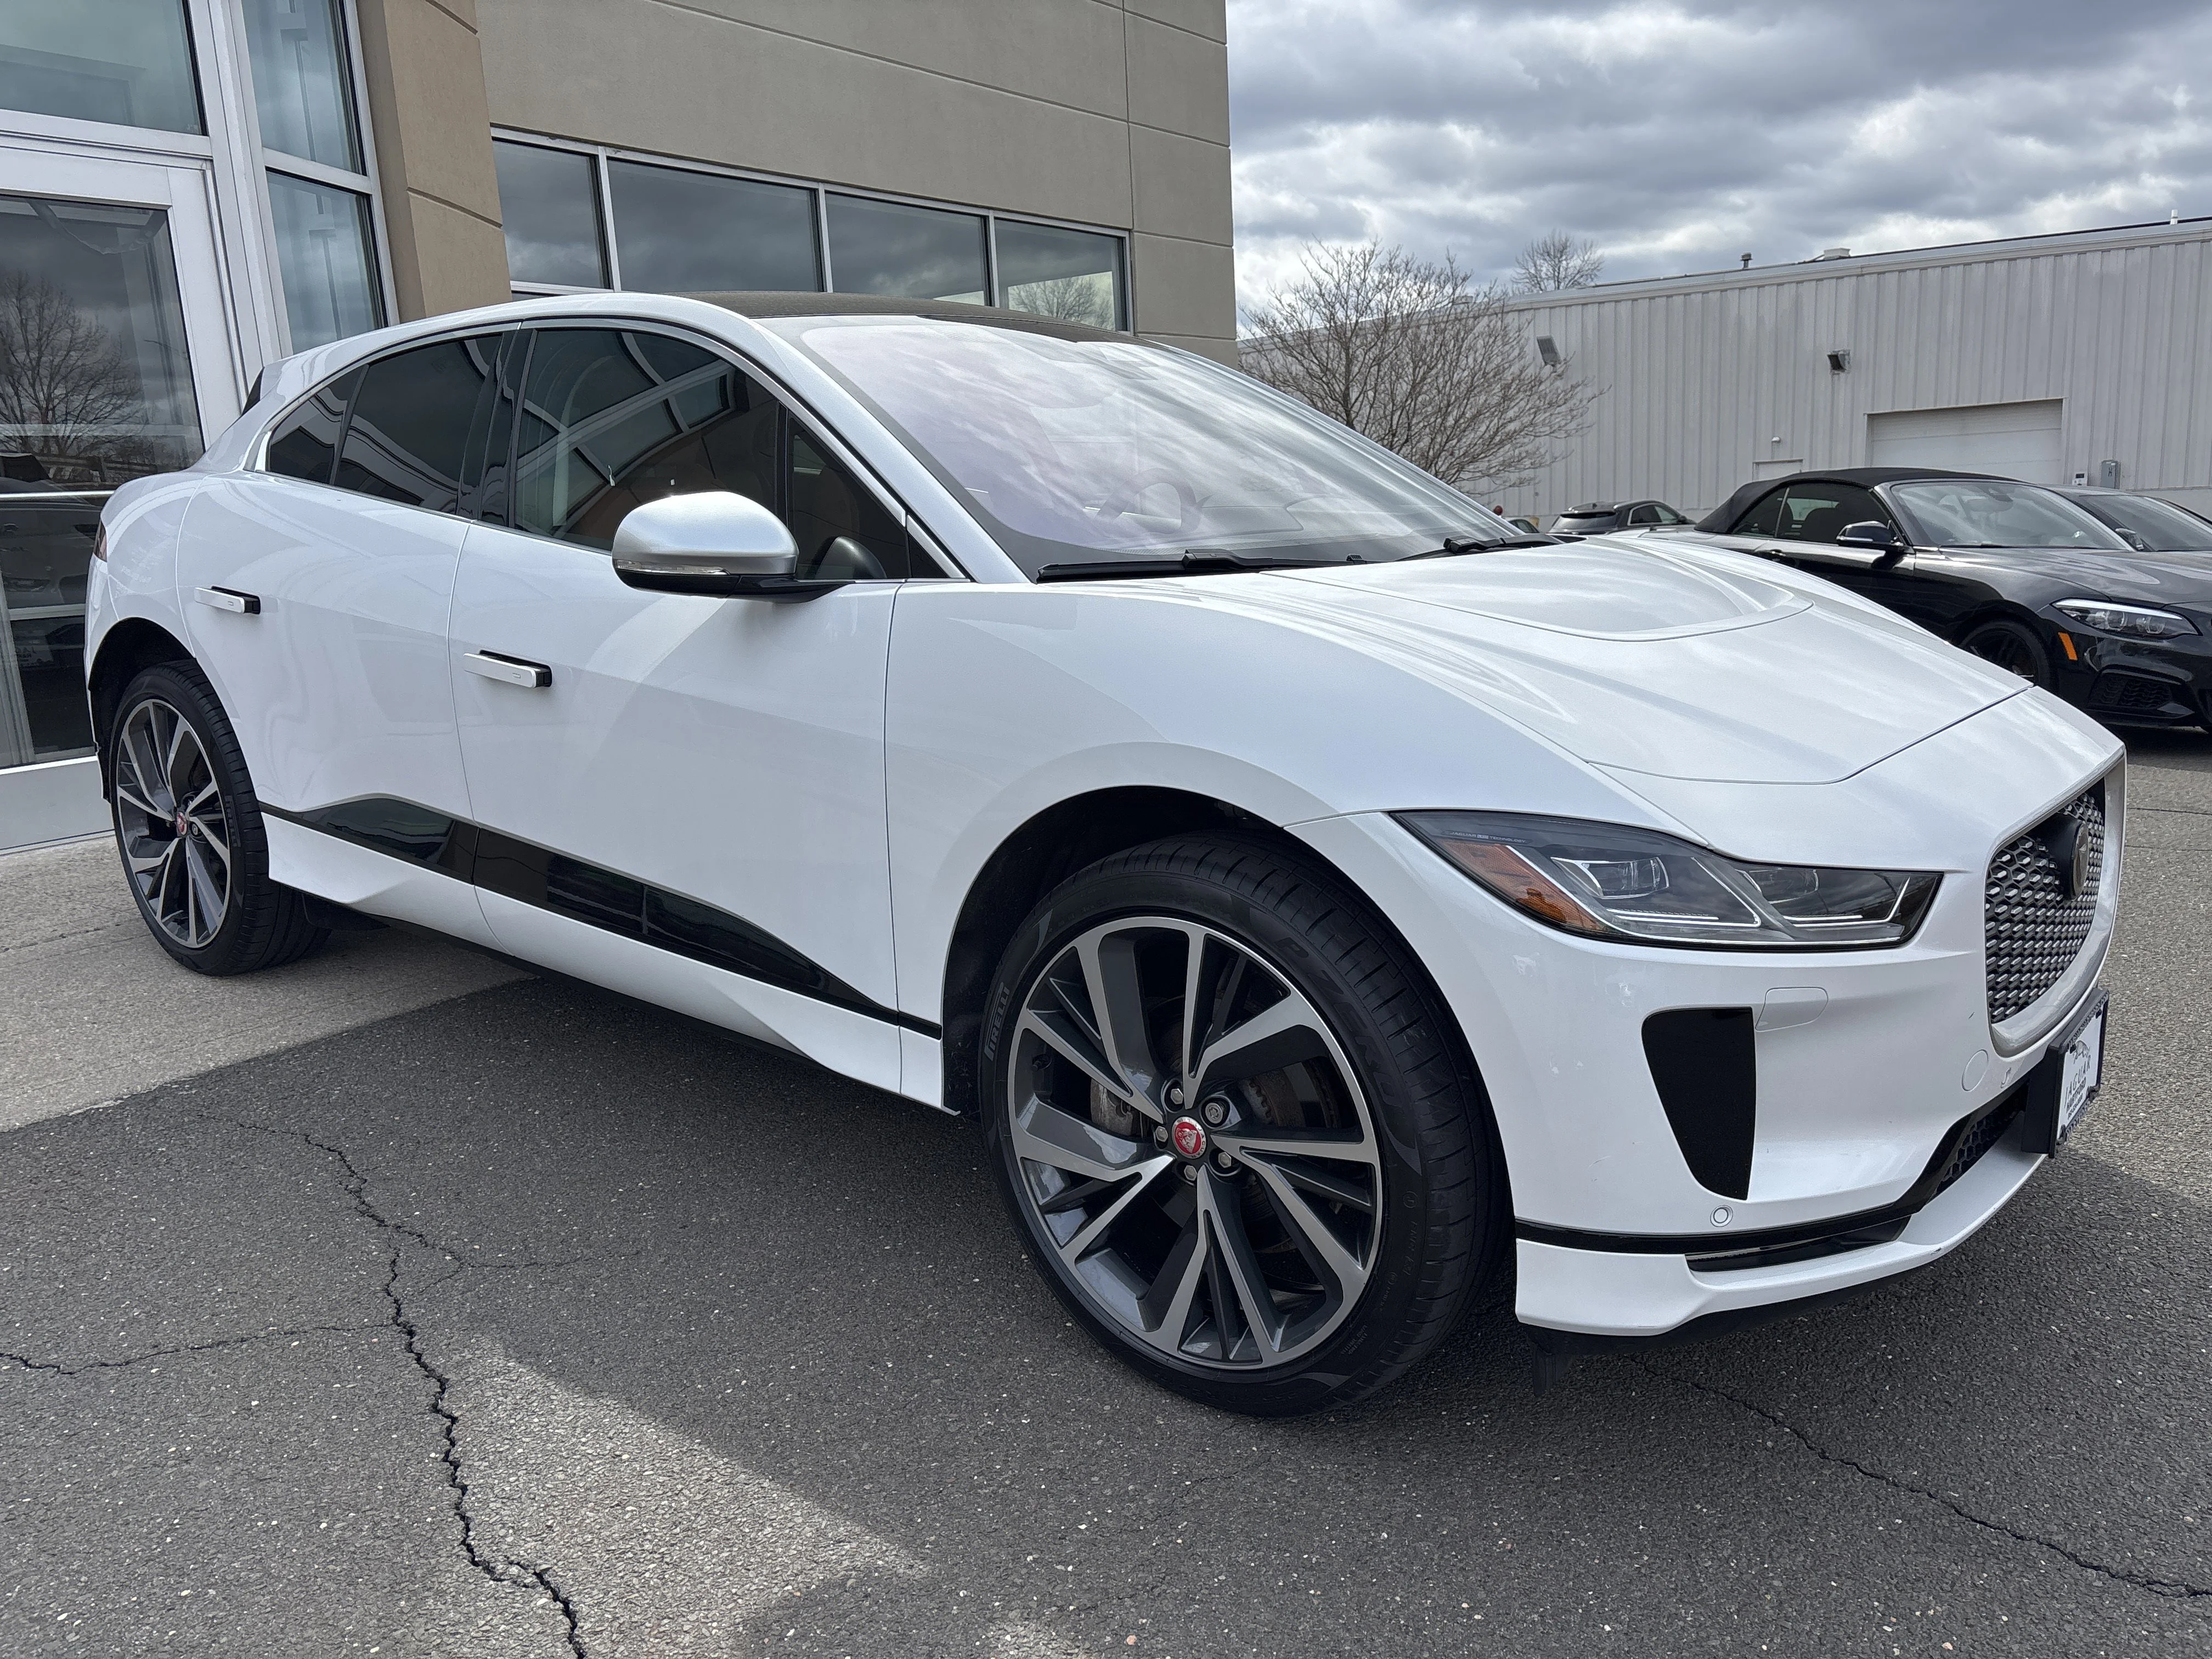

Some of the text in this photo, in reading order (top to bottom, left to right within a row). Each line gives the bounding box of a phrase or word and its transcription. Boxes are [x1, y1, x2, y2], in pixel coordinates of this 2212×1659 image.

[984, 982, 1010, 1061] PIRELLI
[1306, 969, 1402, 1108] ZERO
[2064, 1054, 2091, 1109] JAGUAR
